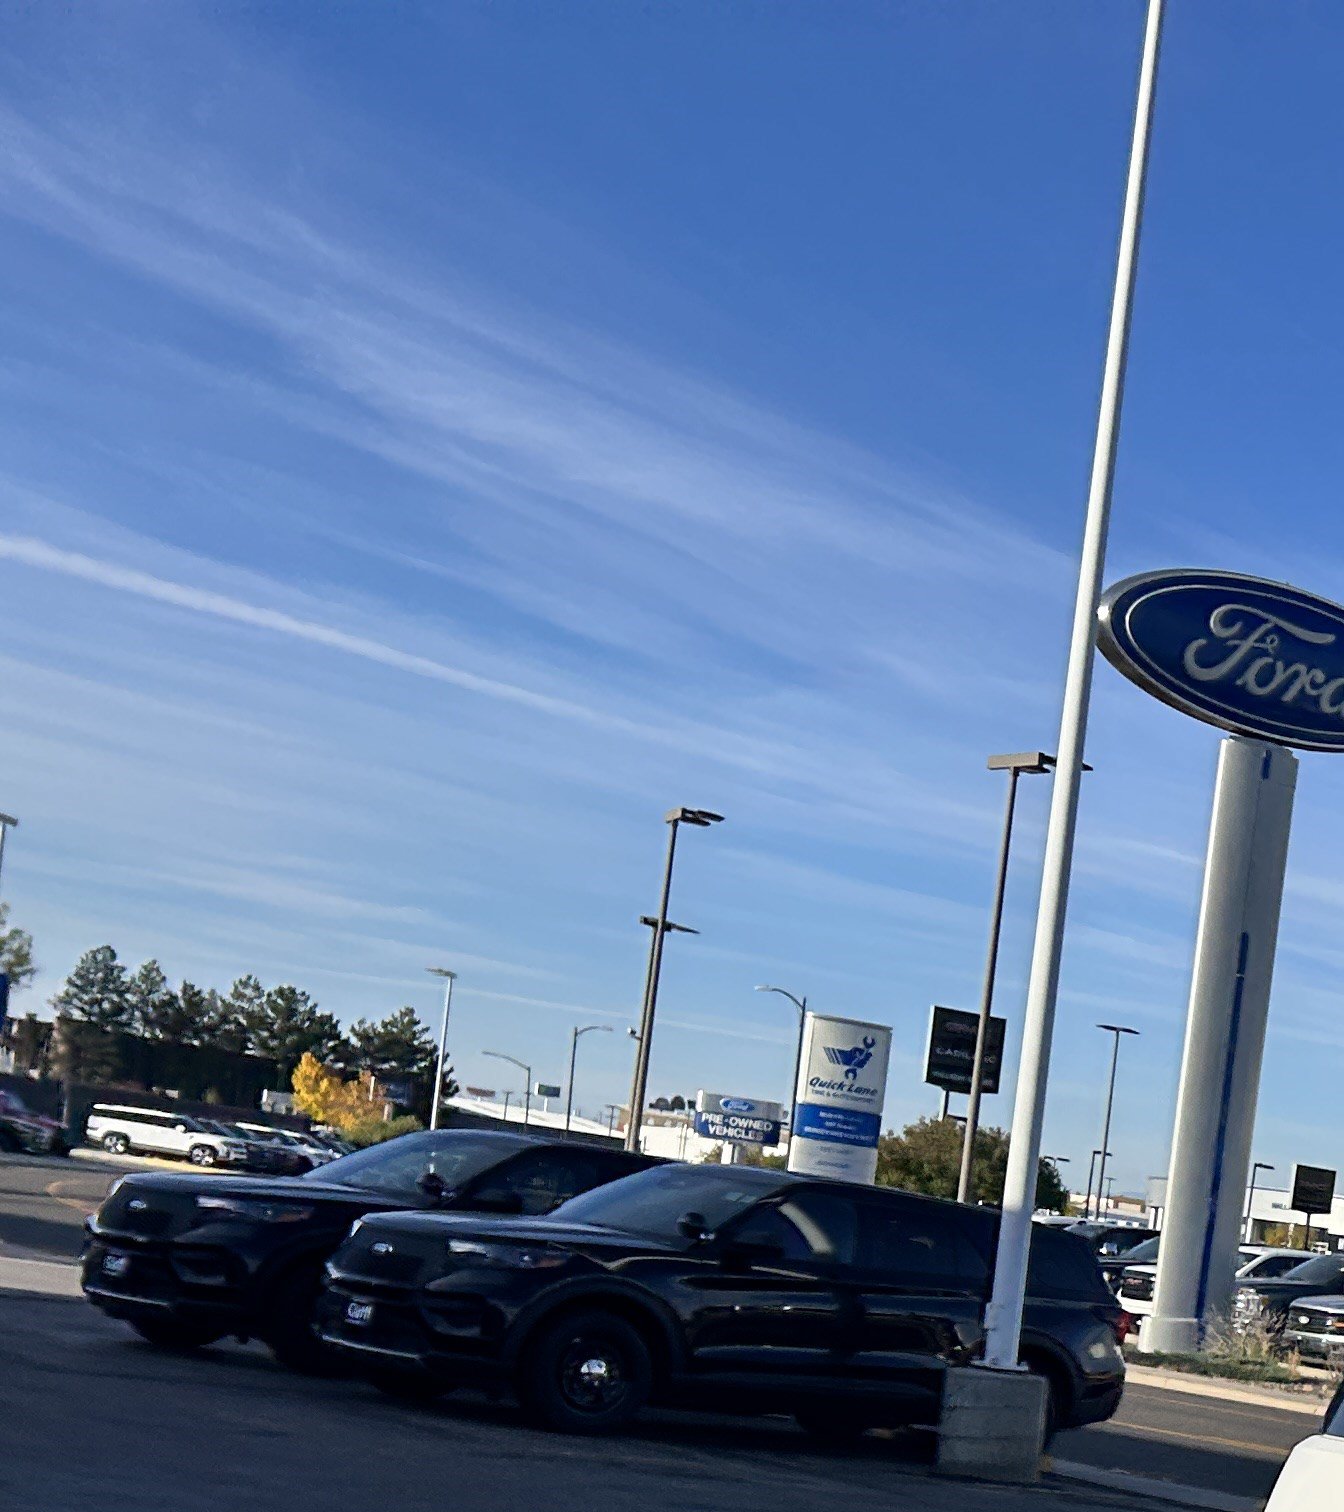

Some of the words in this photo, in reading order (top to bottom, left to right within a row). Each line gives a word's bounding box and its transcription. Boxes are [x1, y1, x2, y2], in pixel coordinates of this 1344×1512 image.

[809, 1076, 847, 1092] Quick
[847, 1083, 878, 1097] Lane
[701, 1112, 773, 1132] PRE-OWNED
[708, 1123, 764, 1141] VEHICLES
